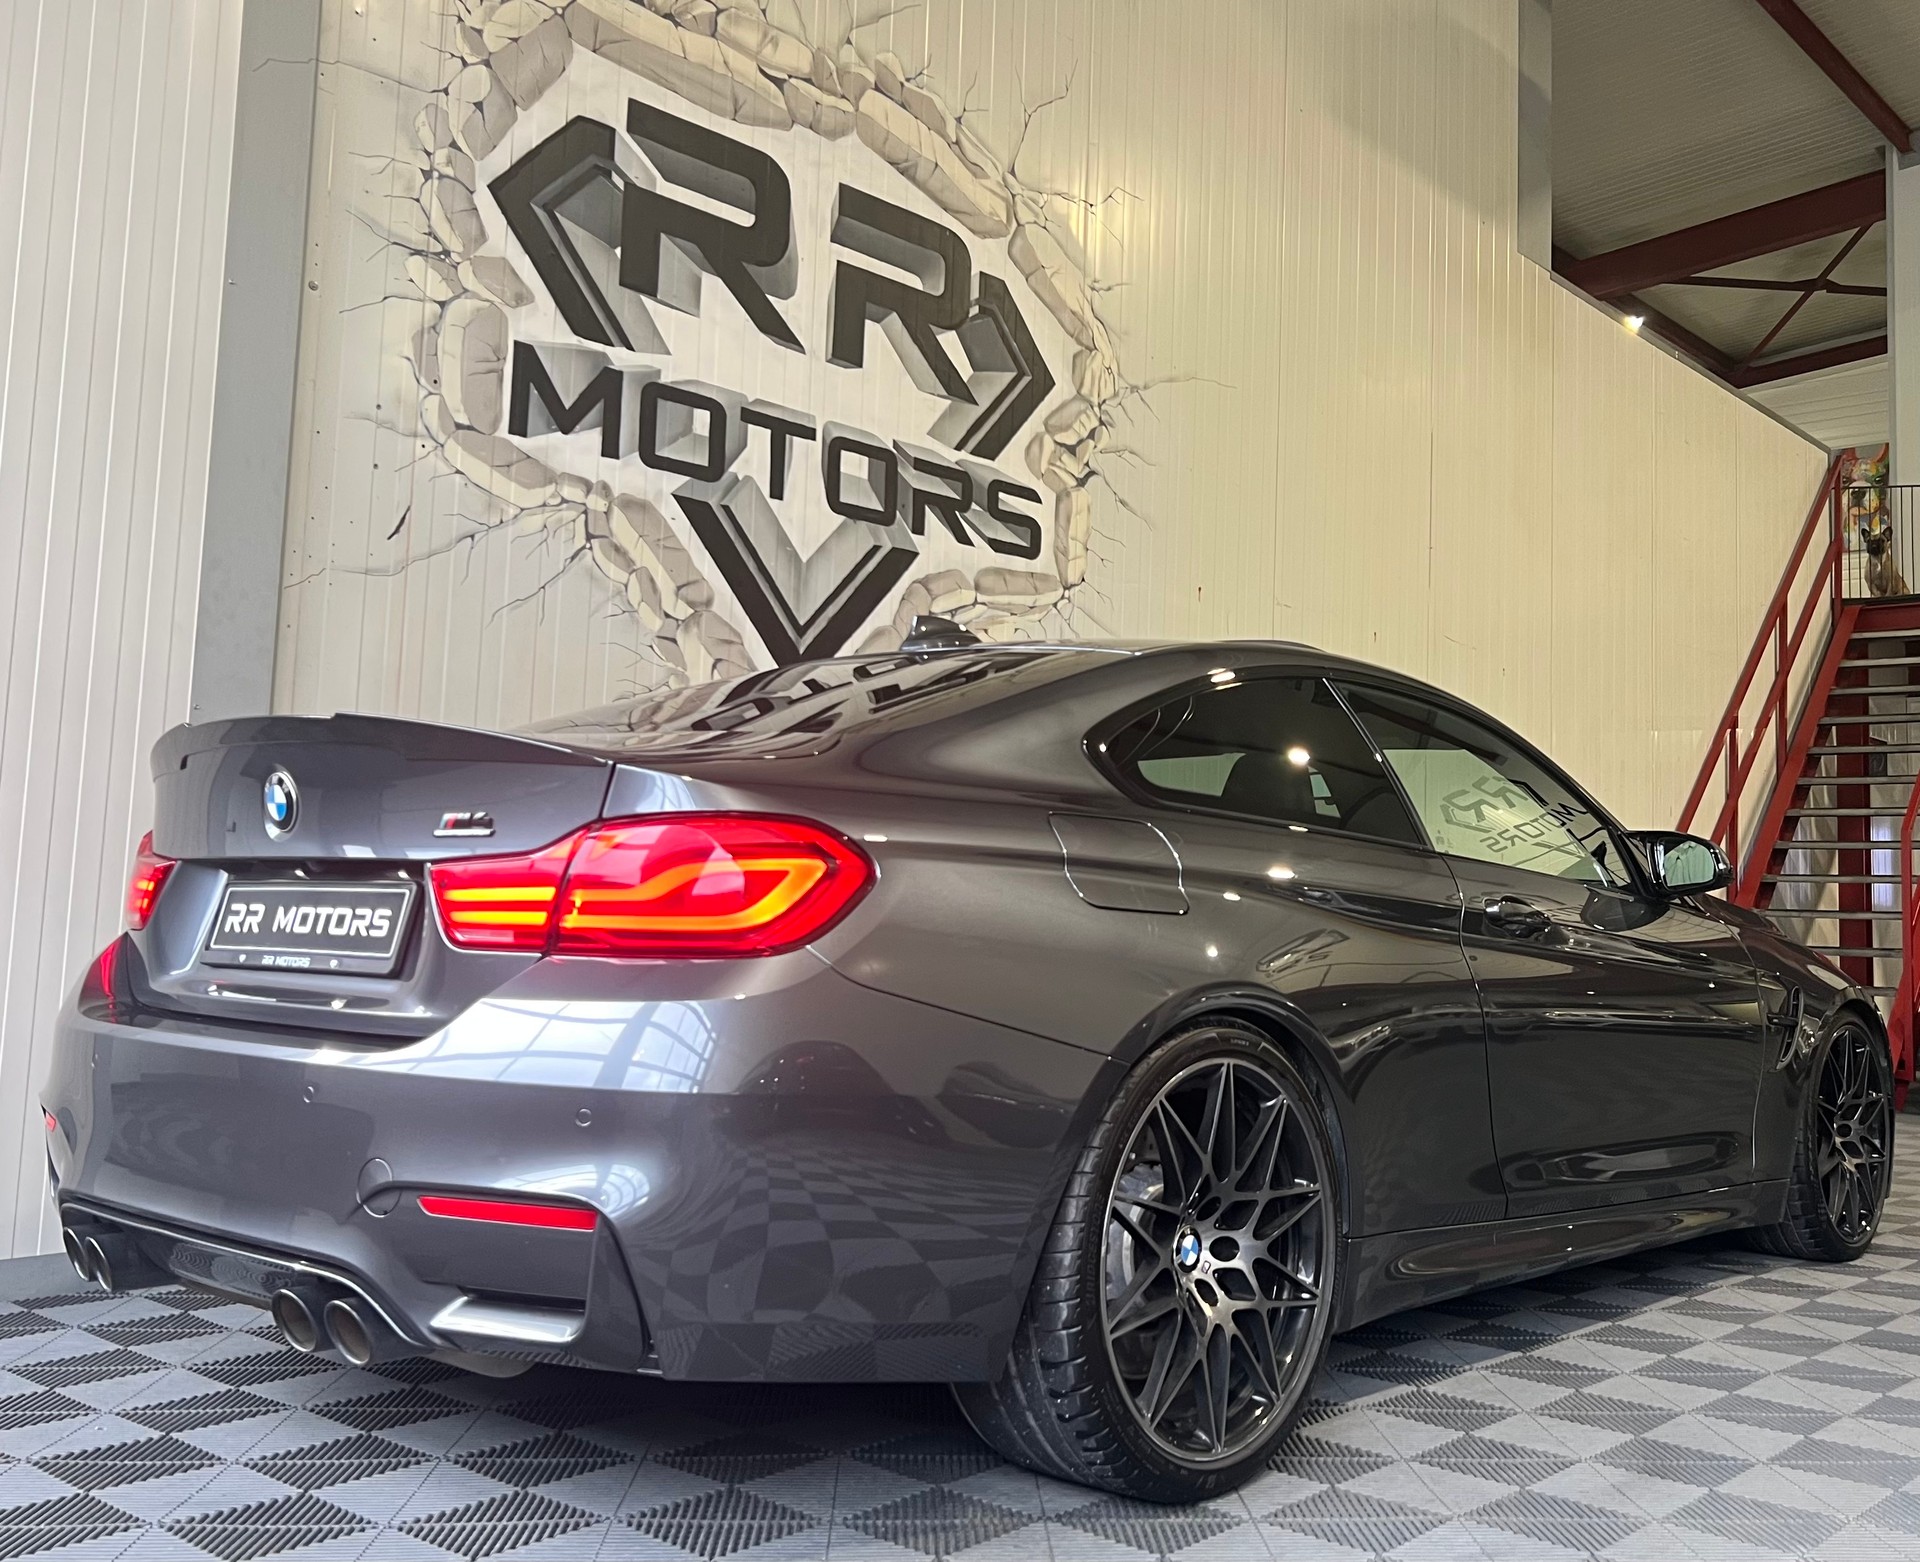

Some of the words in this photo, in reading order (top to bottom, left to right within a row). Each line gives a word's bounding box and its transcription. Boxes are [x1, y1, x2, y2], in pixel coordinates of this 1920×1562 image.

[618, 97, 979, 406] RR
[508, 339, 1044, 561] MOTORS
[224, 903, 266, 934] RR
[272, 905, 392, 938] MOTORS
[275, 956, 311, 968] MOTORS
